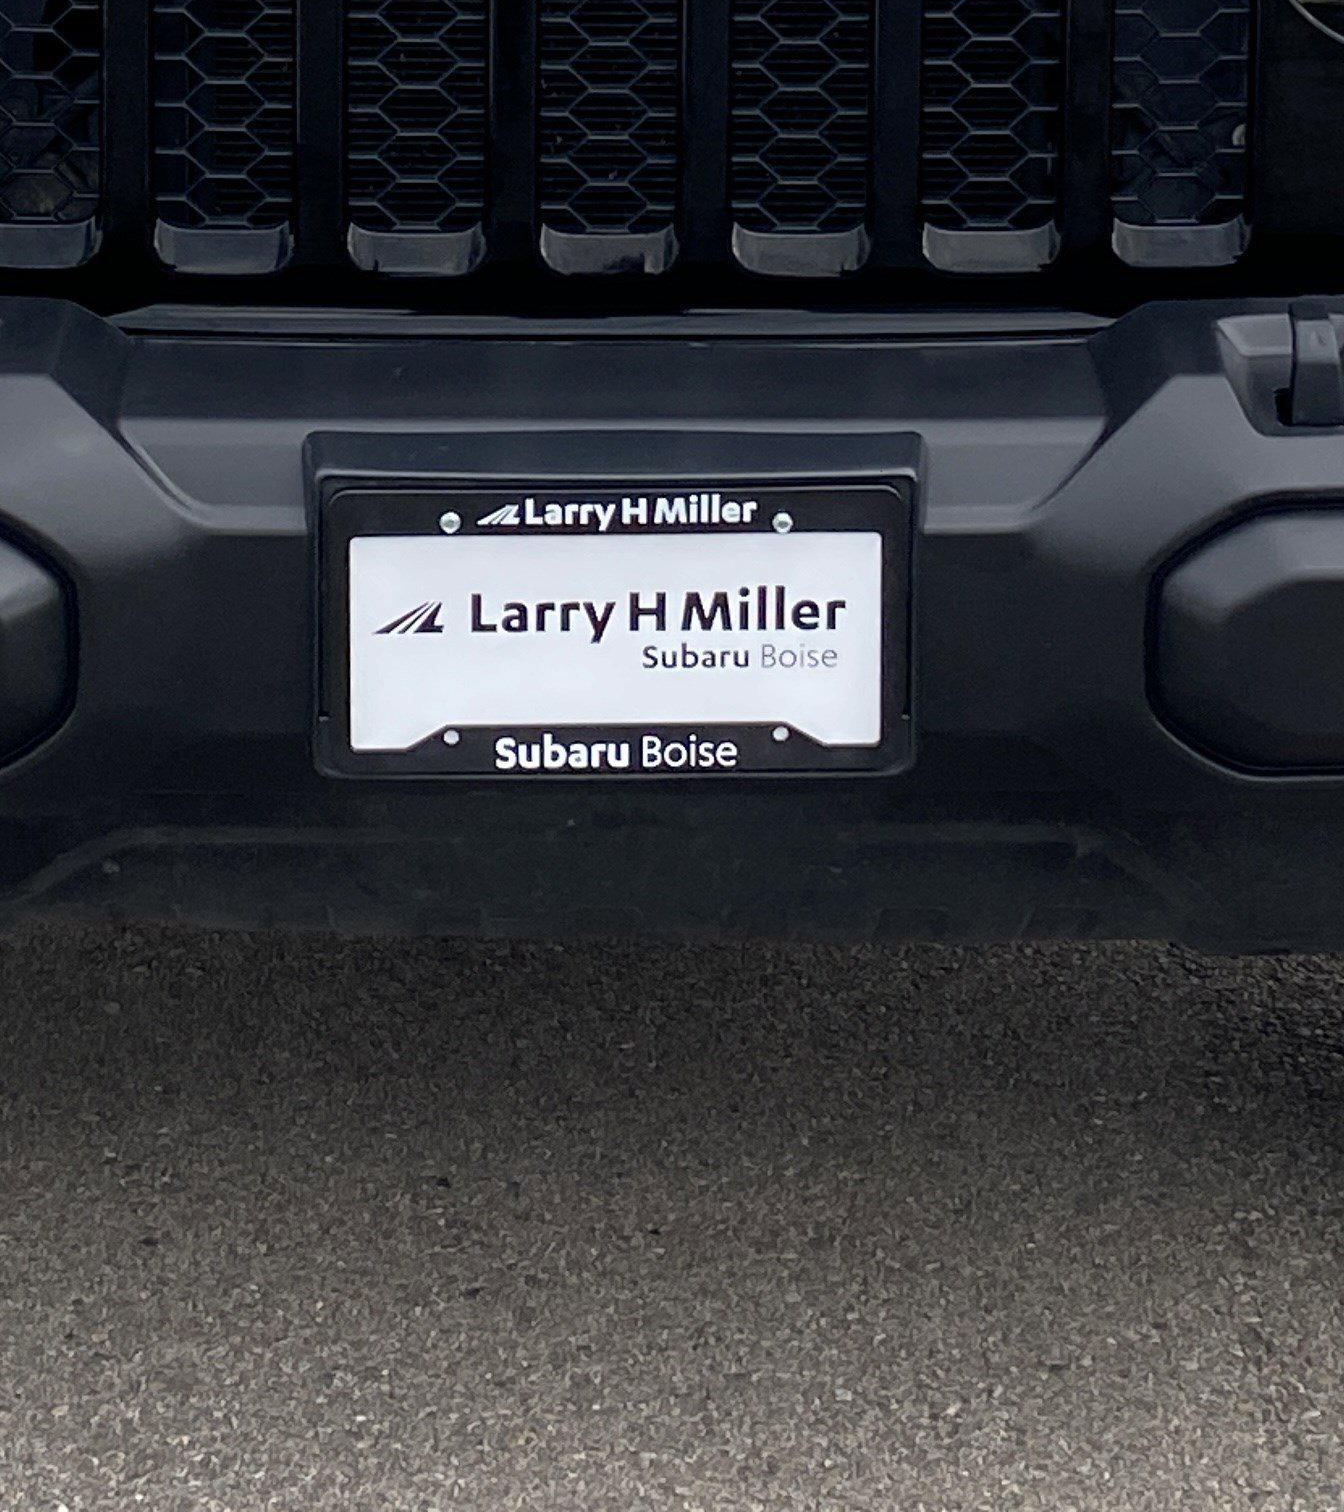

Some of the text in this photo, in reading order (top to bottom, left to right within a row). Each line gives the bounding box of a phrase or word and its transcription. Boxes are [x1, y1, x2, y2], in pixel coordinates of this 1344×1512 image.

[524, 494, 757, 531] Larry H Miller
[470, 585, 847, 643] Larry H Miller
[641, 643, 838, 669] Subaru Boise
[494, 734, 739, 770] Subaru Boise
